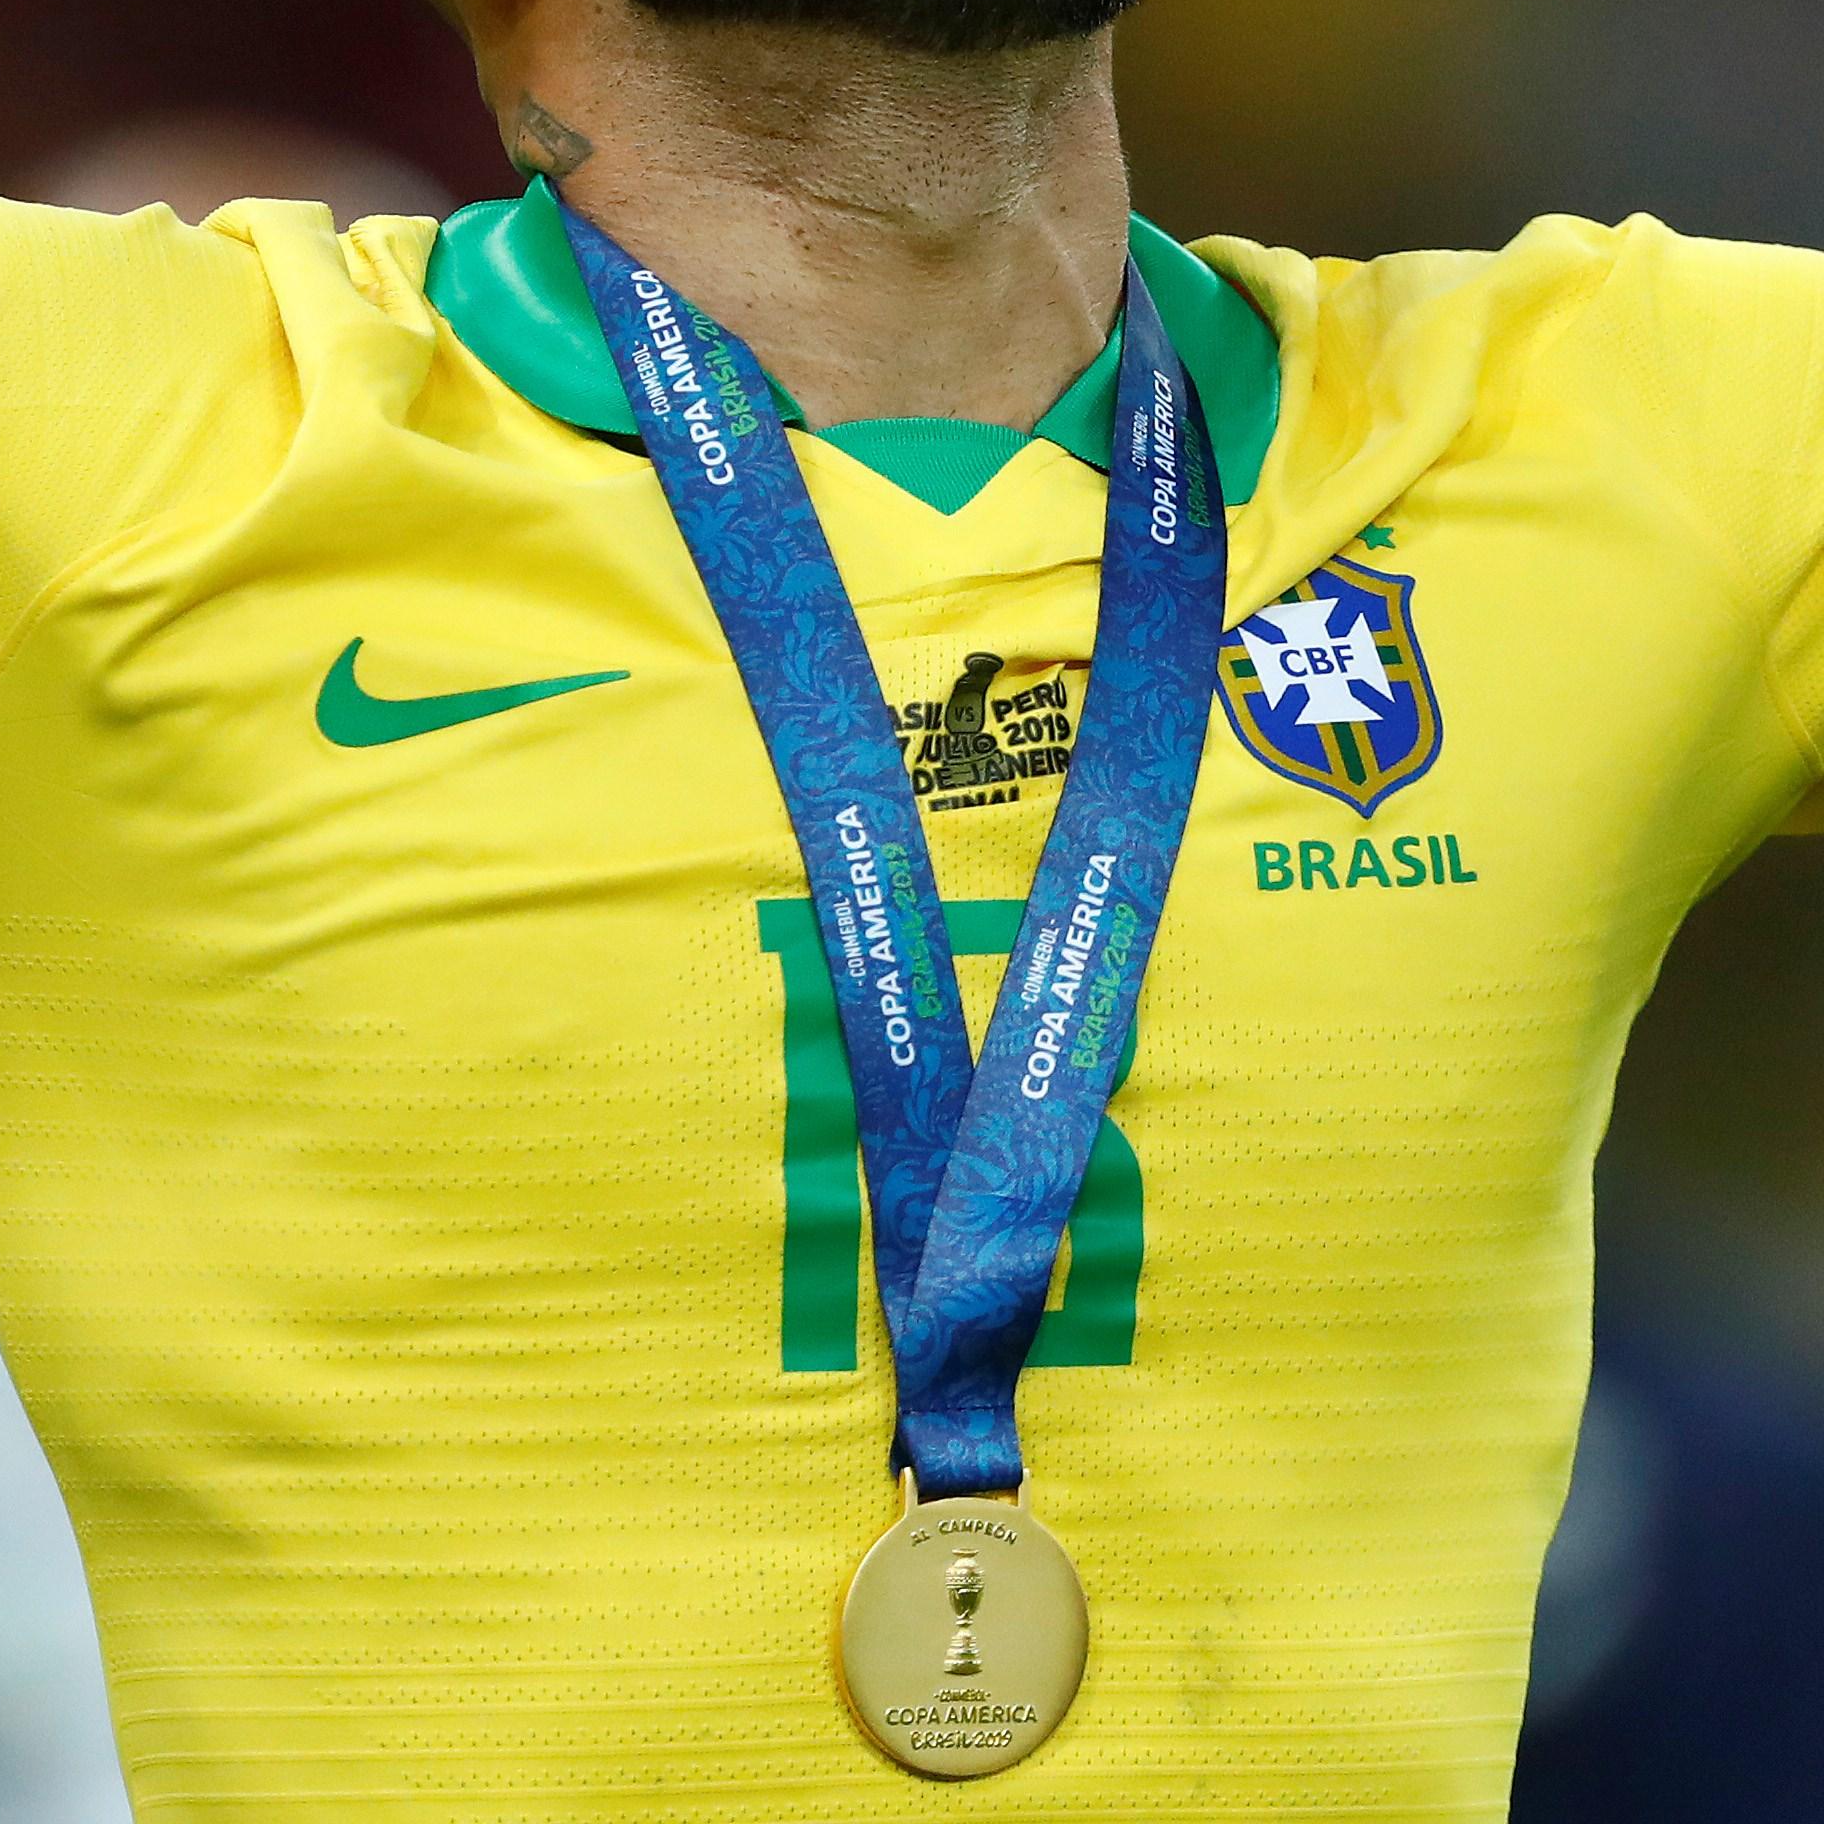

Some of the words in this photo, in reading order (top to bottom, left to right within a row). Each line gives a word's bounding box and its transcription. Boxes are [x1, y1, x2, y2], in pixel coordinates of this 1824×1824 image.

[630, 269, 703, 393] AMERICA
[682, 397, 736, 486] COPA
[1153, 369, 1177, 478] AMERICA
[1150, 477, 1178, 546] COPA
[1278, 643, 1355, 678] CBF
[915, 732, 998, 764] JULIO
[1001, 713, 1072, 747] 2019
[953, 705, 975, 723] VS
[911, 766, 953, 796] DE
[964, 745, 1071, 787] JANEIR
[835, 804, 897, 964] AMERICA
[1253, 834, 1477, 892] BRASIL
[1101, 903, 1141, 968] 2019
[1020, 1010, 1071, 1101] COPA
[1051, 854, 1117, 1006] AMERICA
[875, 969, 917, 1067] COPA
[937, 1518, 1018, 1546] CAMPEÓN
[884, 1705, 941, 1726] COPA
[944, 1703, 1038, 1725] AMERICA
[972, 1728, 1013, 1749] 2019
